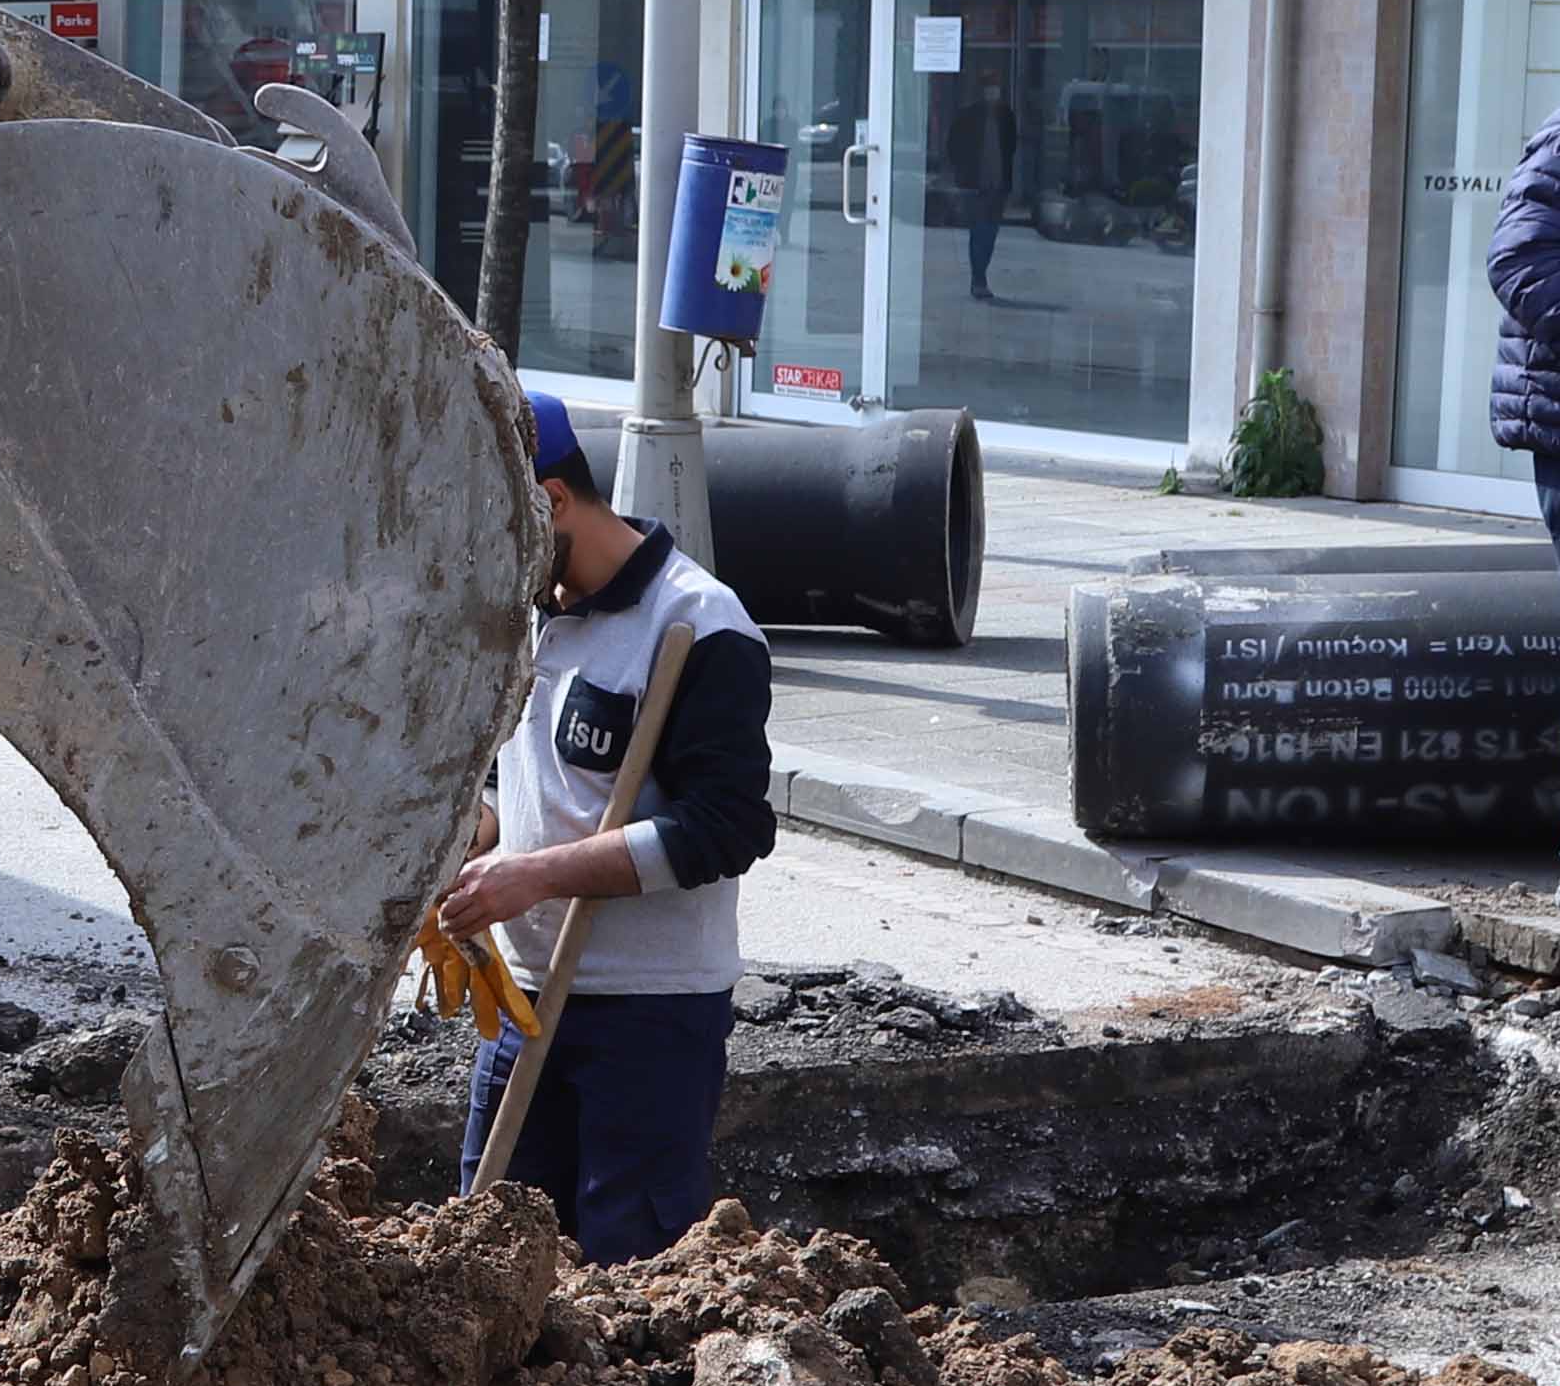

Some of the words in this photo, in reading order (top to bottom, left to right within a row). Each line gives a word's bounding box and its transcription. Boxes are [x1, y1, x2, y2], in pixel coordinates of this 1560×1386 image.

[55, 13, 92, 27] Parke
[1423, 175, 1502, 192] TOSYALI
[1455, 635, 1513, 657] Yeri
